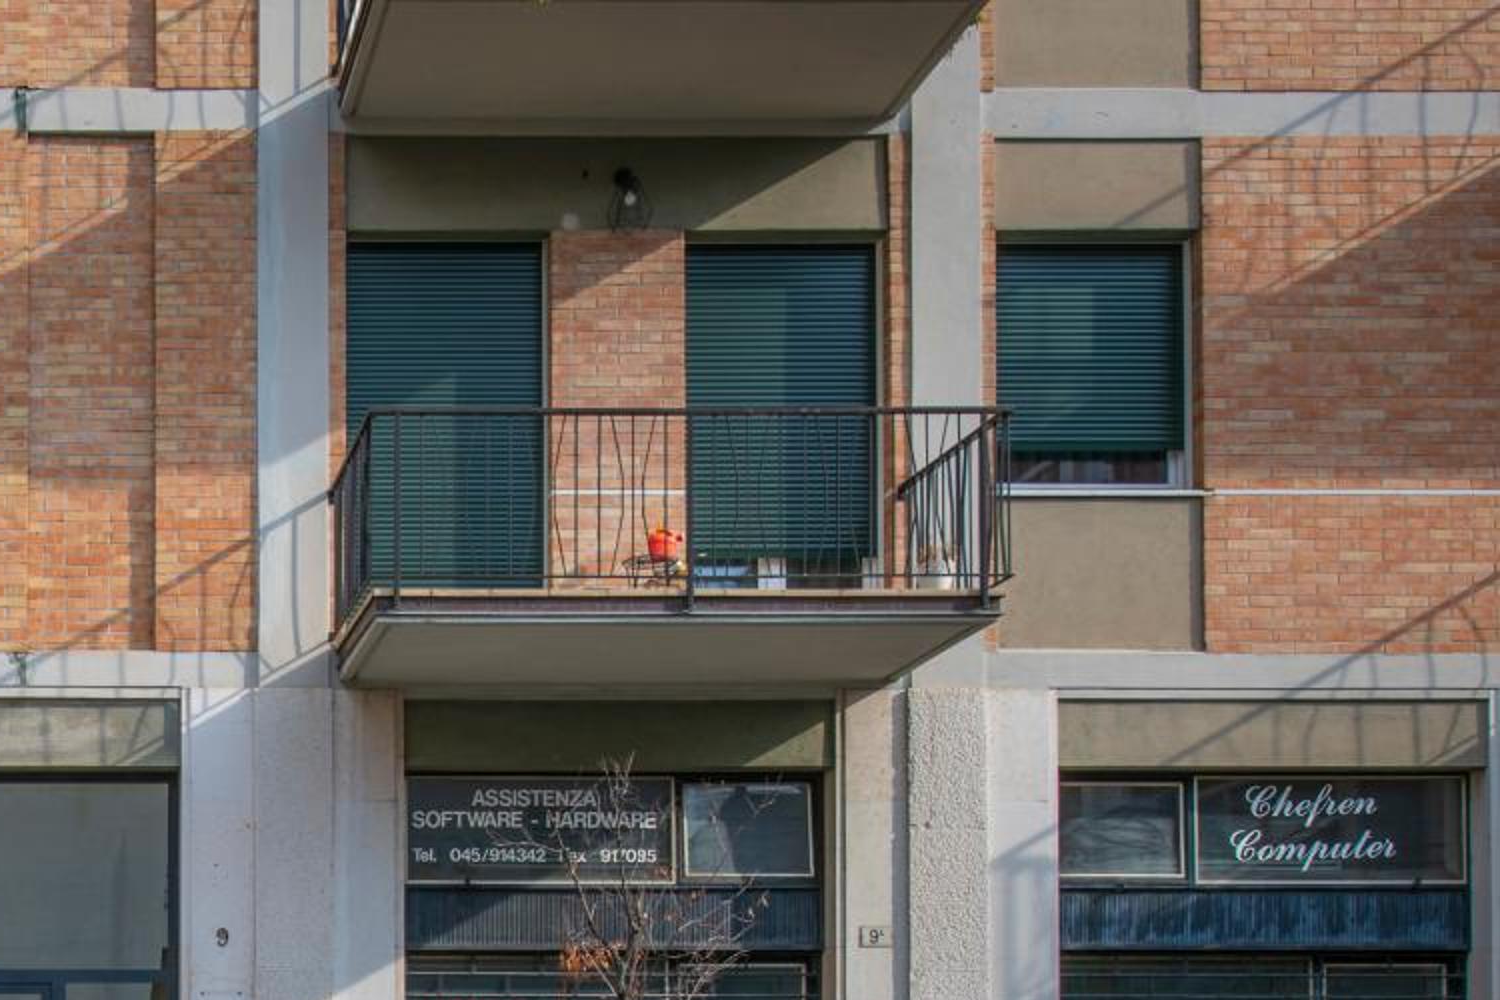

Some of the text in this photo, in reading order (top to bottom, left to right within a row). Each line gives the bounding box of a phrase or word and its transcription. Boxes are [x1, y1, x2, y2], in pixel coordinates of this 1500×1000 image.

[472, 789, 598, 807] ASSISTENZA
[1245, 783, 1379, 828] Chefren
[412, 811, 523, 829] SOFTWARE
[546, 811, 657, 829] HARDWARE
[413, 848, 437, 863] Tel.
[1228, 828, 1397, 872] Computer
[216, 927, 229, 948] 9
